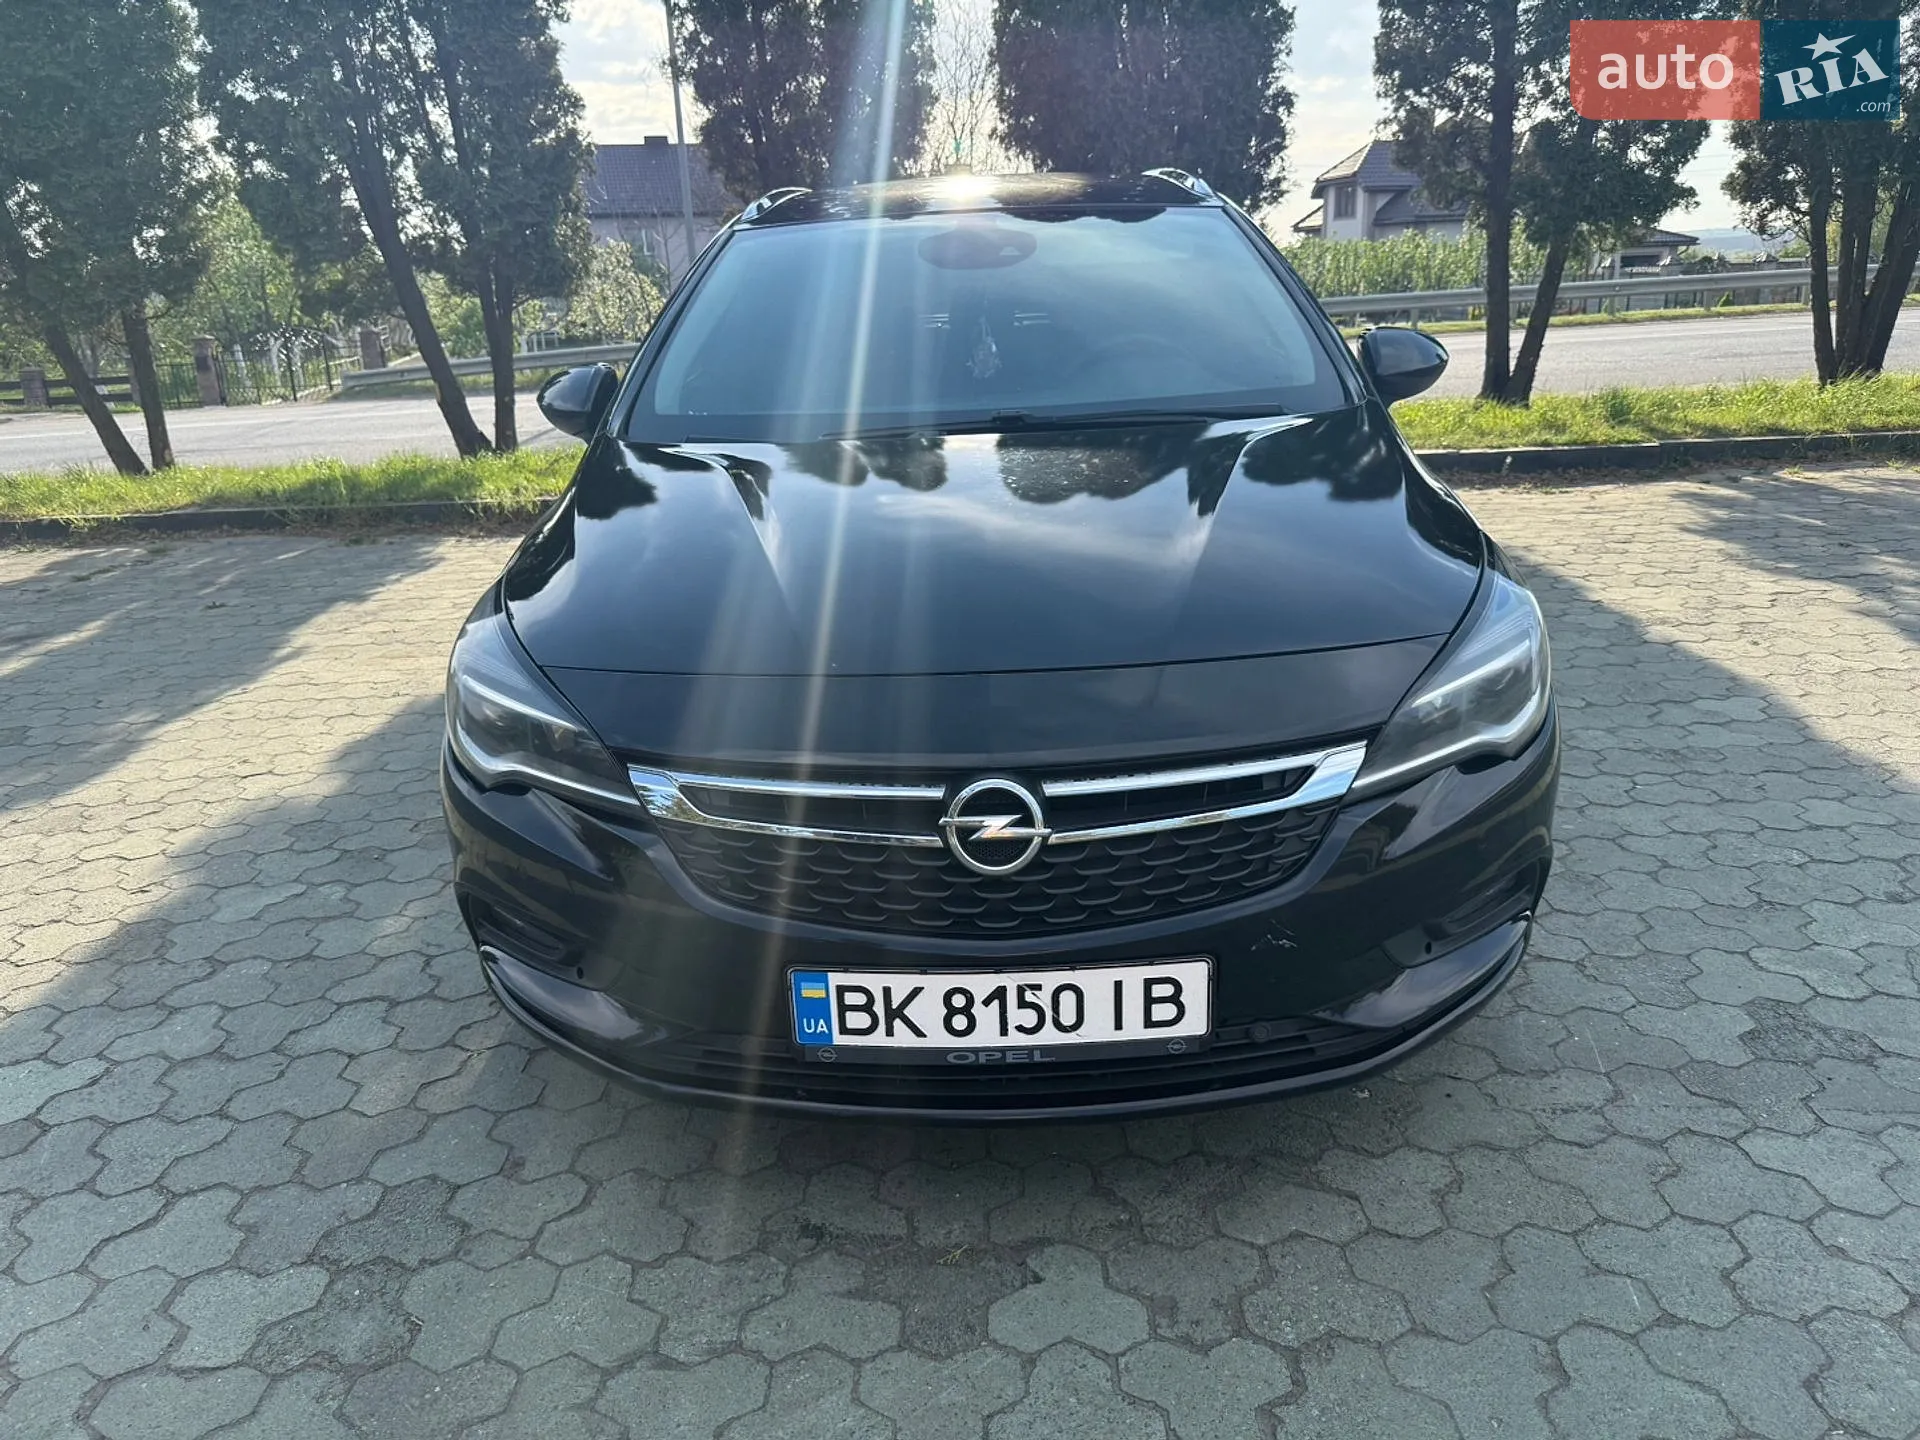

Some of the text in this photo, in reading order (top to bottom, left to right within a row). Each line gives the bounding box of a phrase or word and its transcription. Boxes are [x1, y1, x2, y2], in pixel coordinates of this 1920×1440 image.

[834, 976, 1187, 1039] BK 8150 IB
[803, 1018, 830, 1035] UA
[946, 1050, 1056, 1065] OPEL
